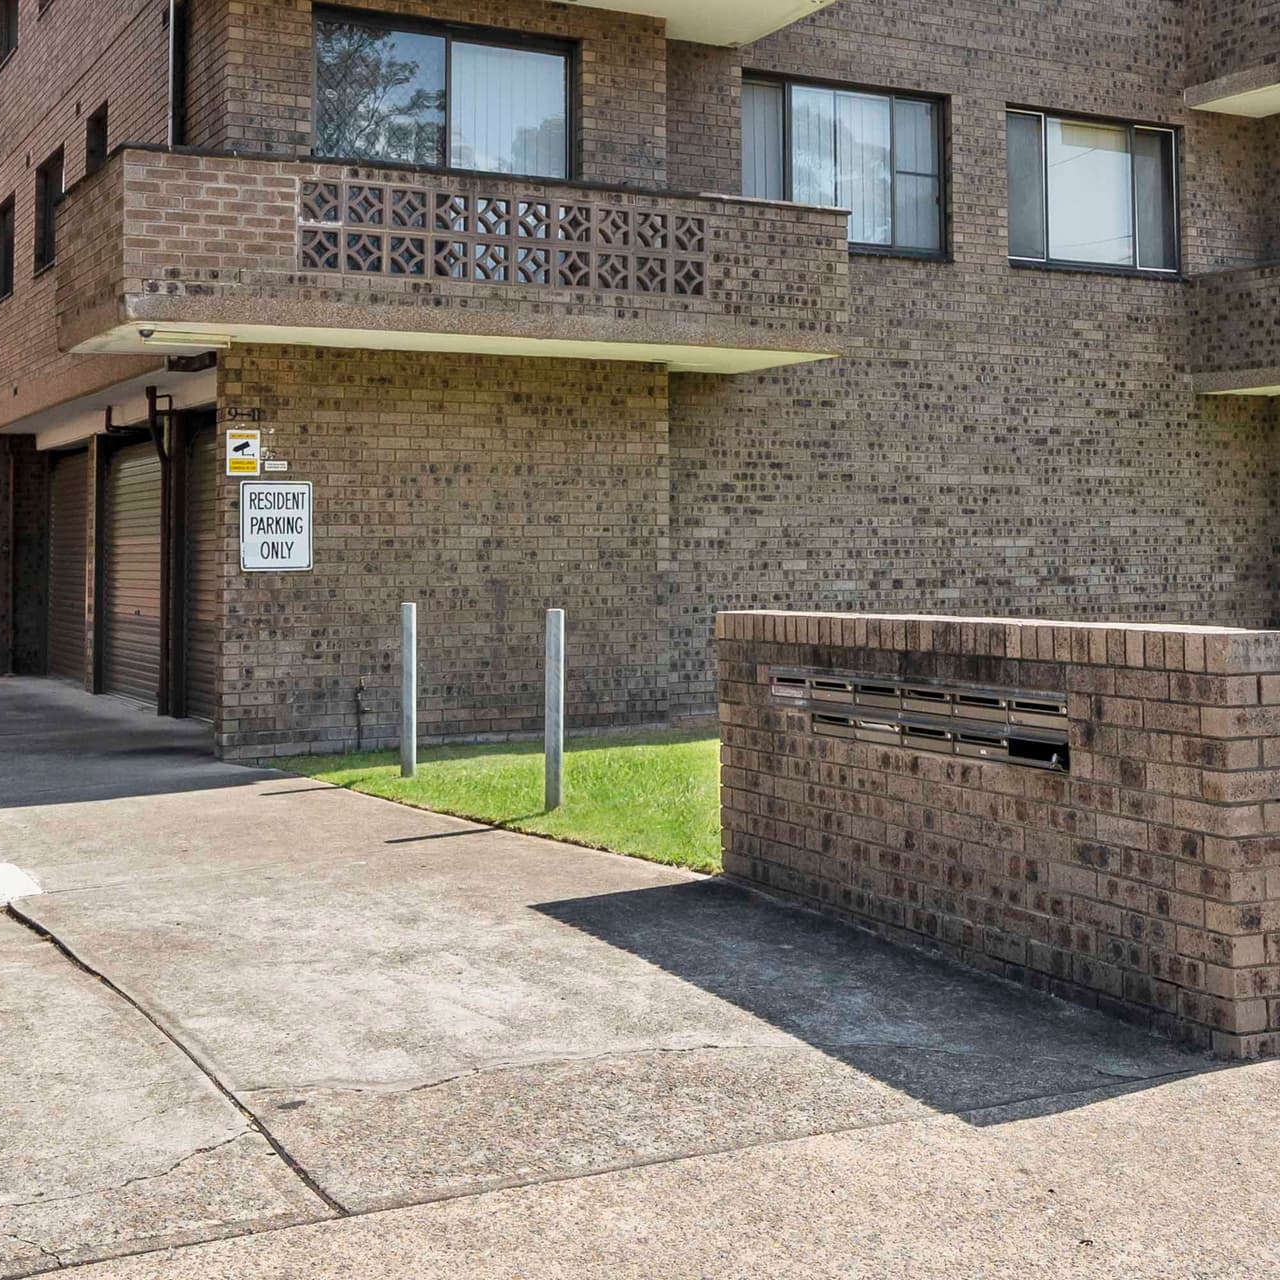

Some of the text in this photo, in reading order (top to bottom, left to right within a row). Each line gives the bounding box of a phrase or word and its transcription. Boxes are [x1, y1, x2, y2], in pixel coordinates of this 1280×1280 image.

[249, 491, 306, 510] RESIDENT
[250, 516, 304, 535] PARKING
[260, 541, 294, 559] ONLY
